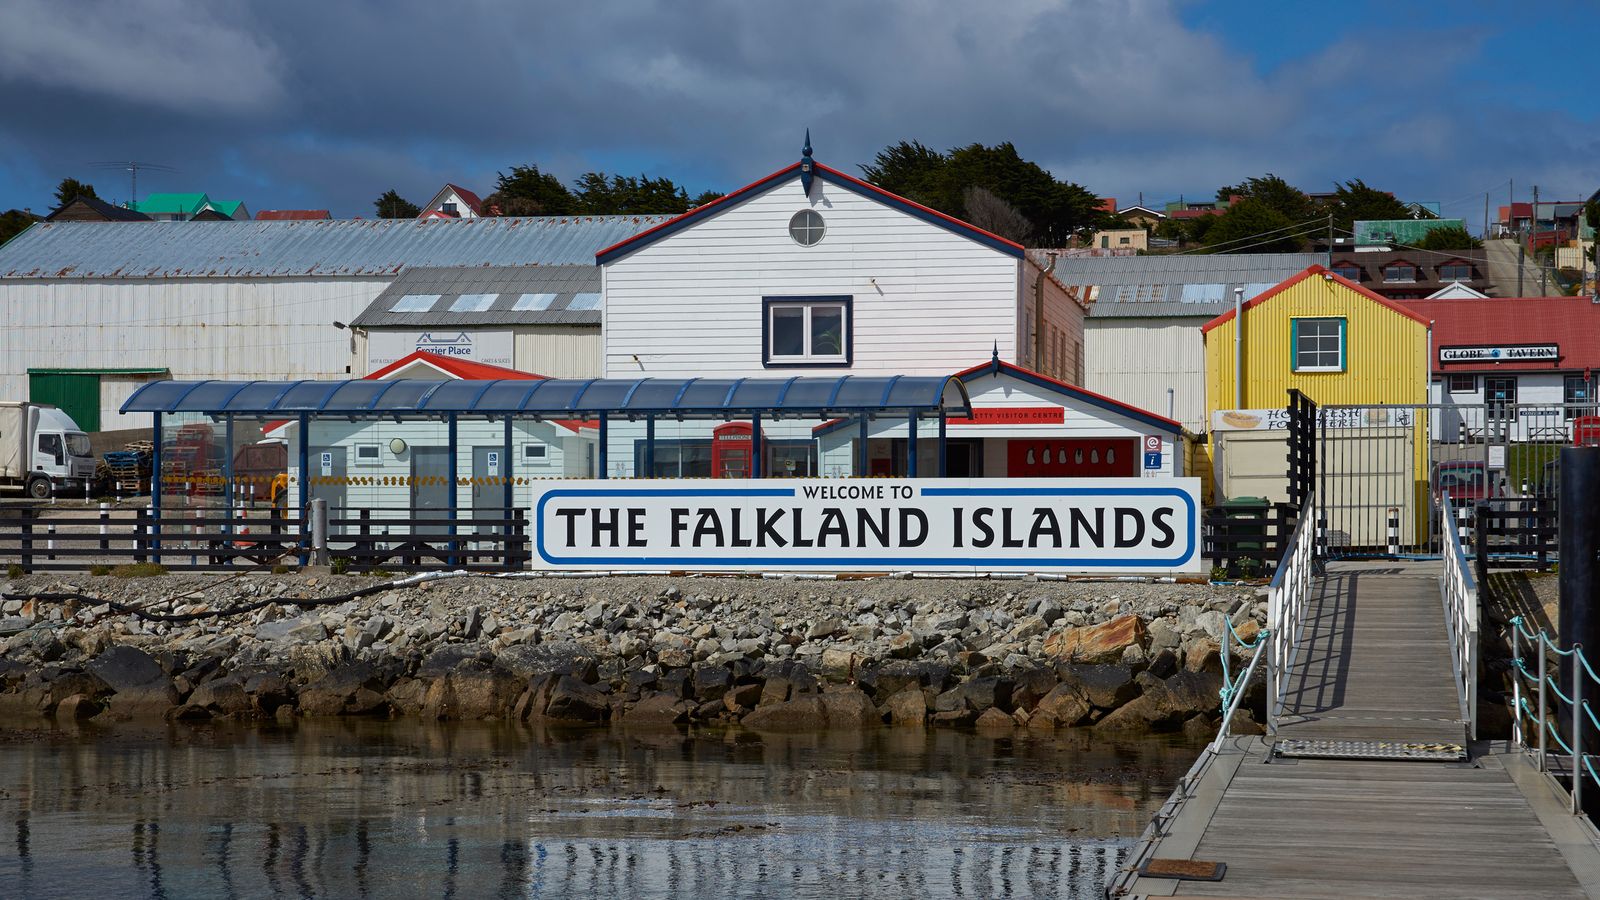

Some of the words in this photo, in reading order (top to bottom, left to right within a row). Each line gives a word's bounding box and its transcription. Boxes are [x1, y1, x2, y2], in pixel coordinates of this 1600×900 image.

[448, 346, 471, 355] Place
[1443, 349, 1484, 359] GLOBE
[1506, 347, 1554, 358] TAVERN
[1032, 411, 1062, 419] CENTRE
[1267, 409, 1293, 420] HO
[1317, 408, 1360, 418] RESH
[803, 485, 884, 500] WELCOME
[891, 485, 914, 500] TO
[556, 508, 648, 548] THE
[670, 507, 929, 548] FALKLAND
[953, 507, 1175, 549] ISLANDS
